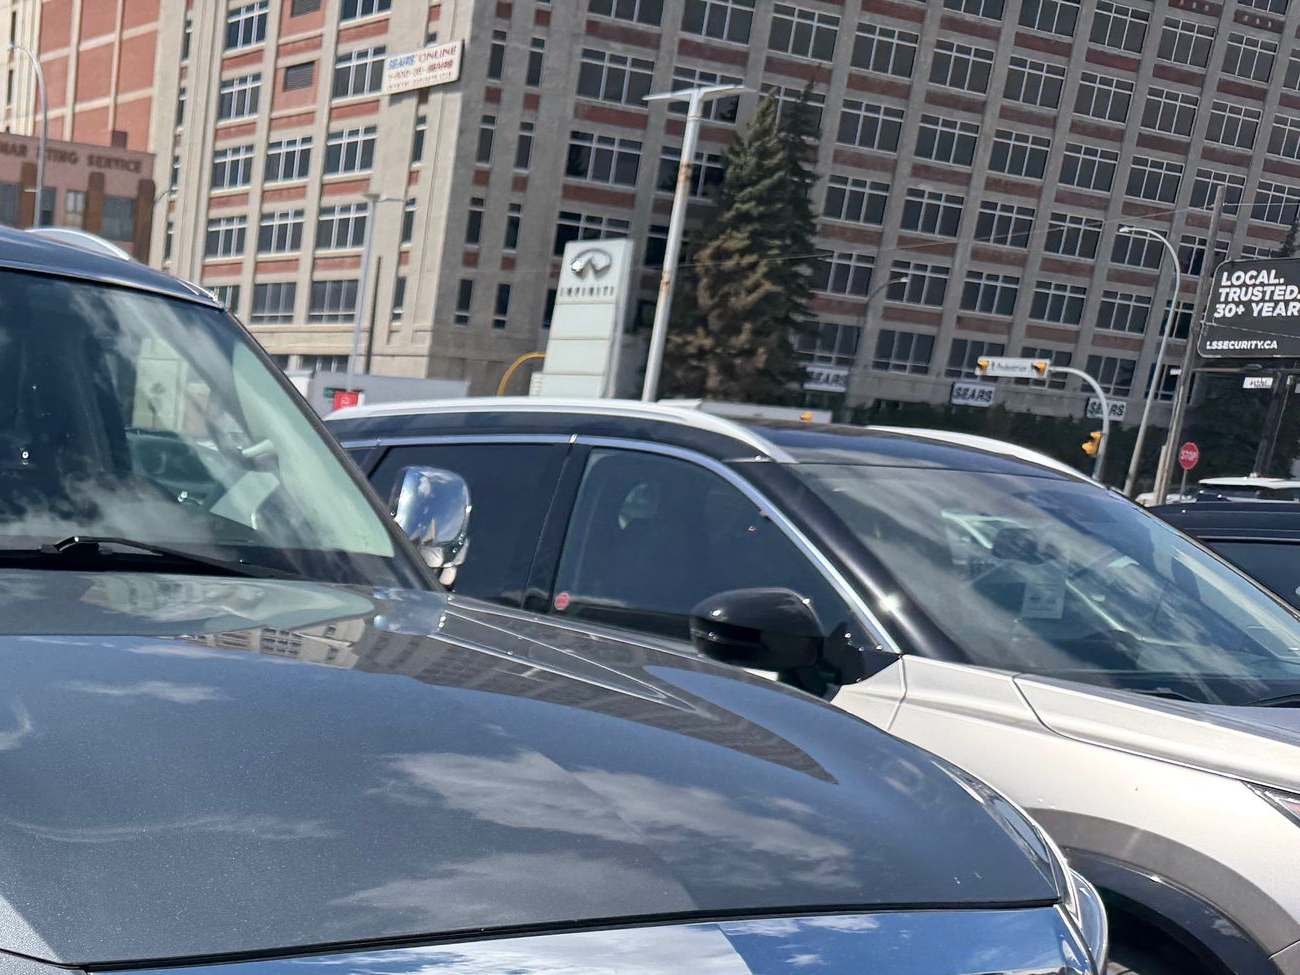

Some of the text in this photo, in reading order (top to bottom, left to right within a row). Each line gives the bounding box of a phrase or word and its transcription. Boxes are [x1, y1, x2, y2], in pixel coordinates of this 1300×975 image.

[87, 154, 142, 173] SERVICE
[1221, 269, 1285, 286] LOCAL.
[1219, 285, 1300, 302] TRUSTED.
[1214, 301, 1300, 318] 30+ YEAR
[1206, 340, 1278, 350] LSSECURITY.CA
[954, 387, 993, 402] SEARS
[1088, 401, 1125, 417] SERS
[1181, 451, 1198, 461] STOP
